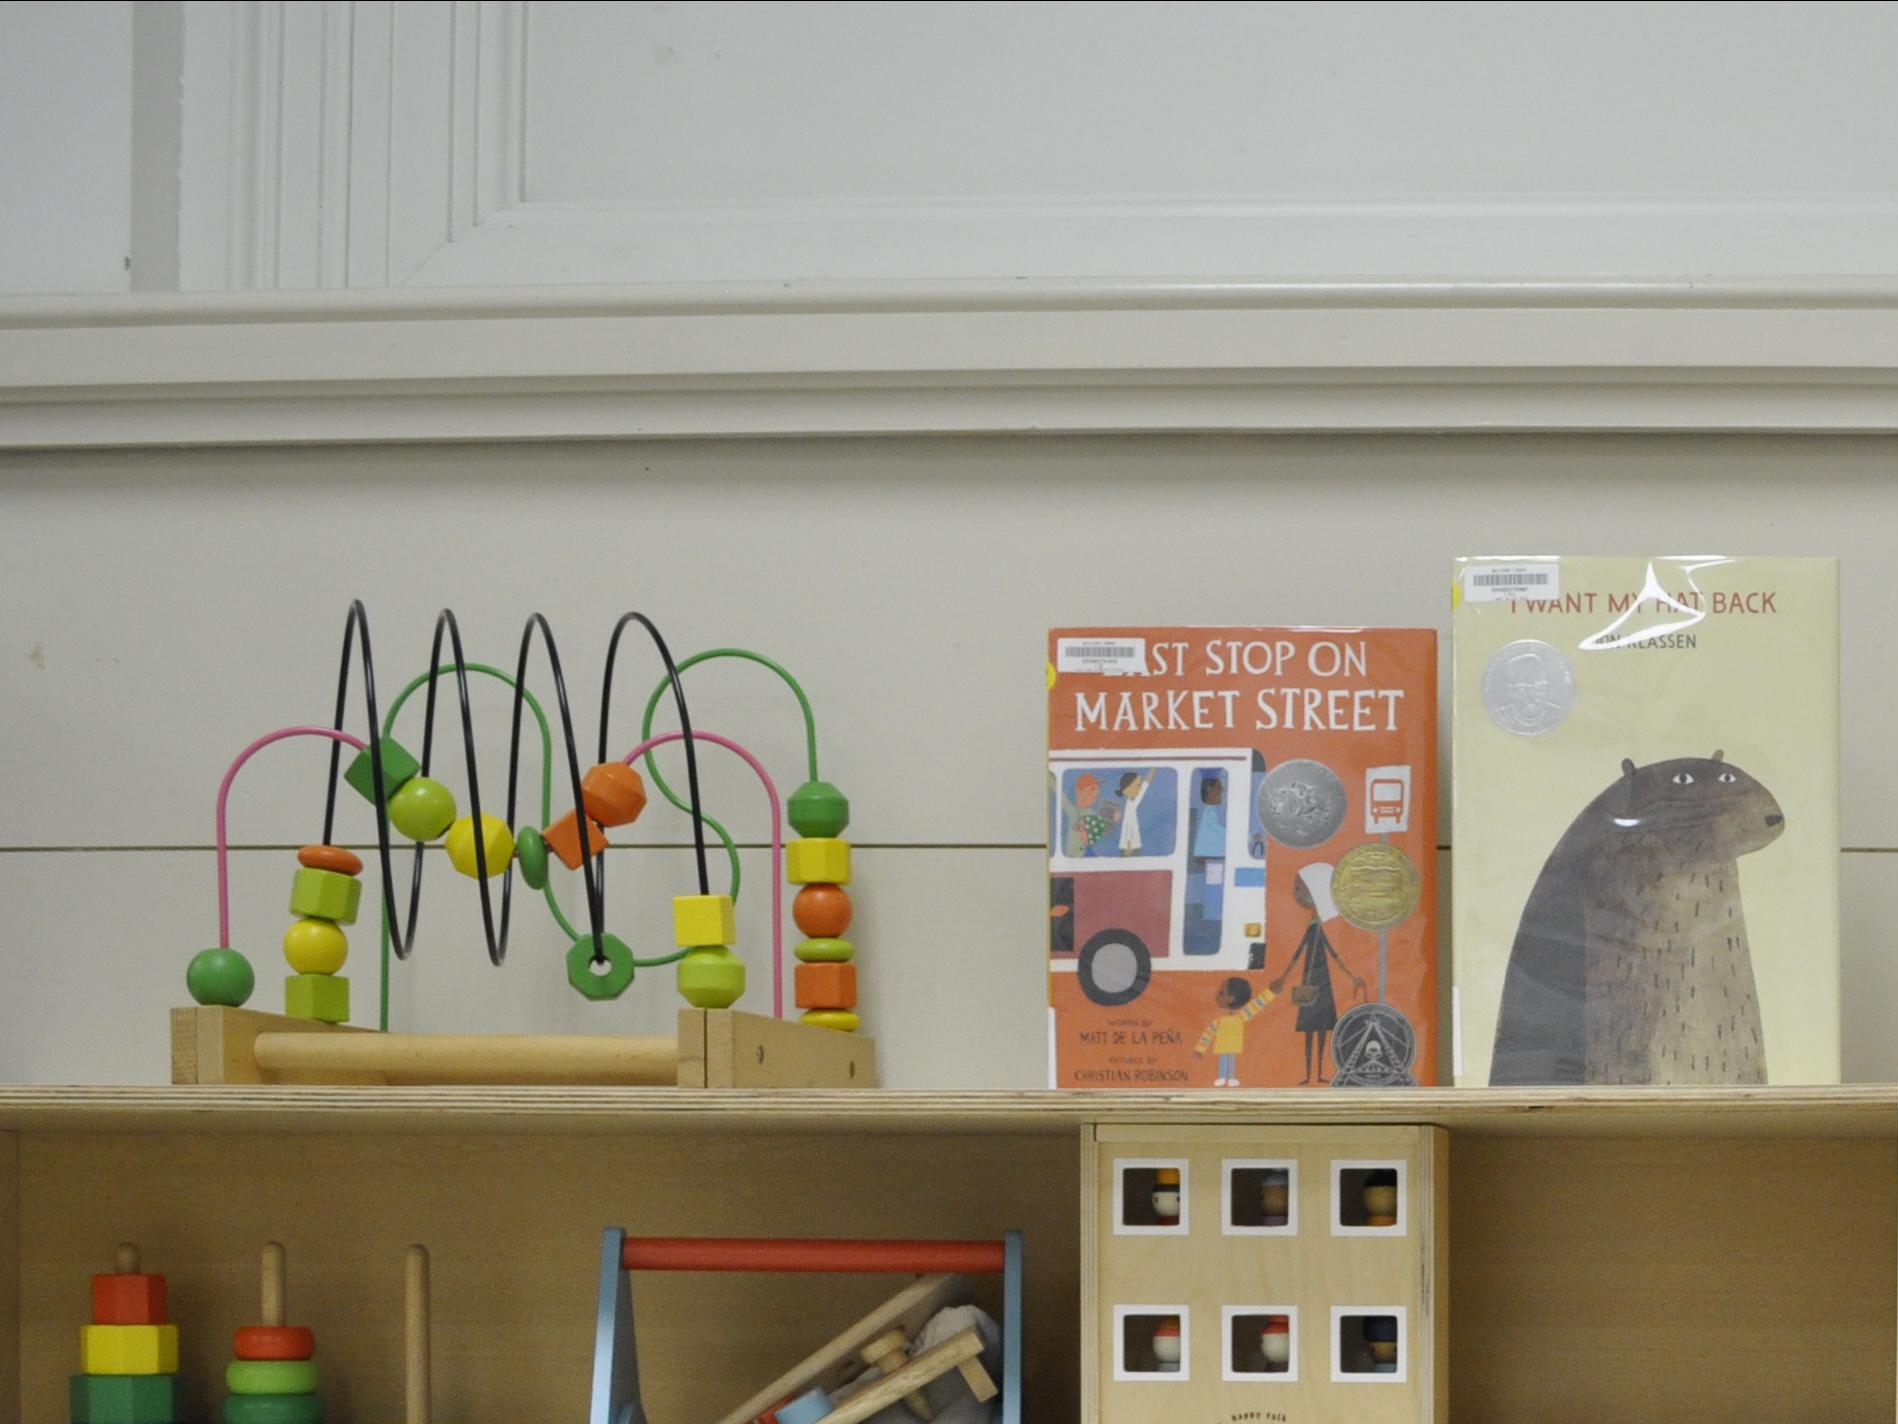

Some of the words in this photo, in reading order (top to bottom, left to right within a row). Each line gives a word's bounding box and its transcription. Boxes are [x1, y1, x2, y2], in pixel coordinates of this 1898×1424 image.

[1526, 592, 1598, 613] WANT
[1712, 591, 1777, 614] BACK
[1206, 640, 1295, 676] STOP
[1307, 641, 1367, 677] ON
[1075, 690, 1240, 731] MARKET
[1255, 688, 1405, 732] STREET
[1080, 1031, 1109, 1044] MATT
[1112, 1031, 1128, 1044] DE
[1131, 1031, 1148, 1044] LA
[1152, 1028, 1184, 1045] PEÑA
[1073, 1069, 1131, 1081] CHRISTIAN
[1134, 1069, 1189, 1081] ROBINSON
